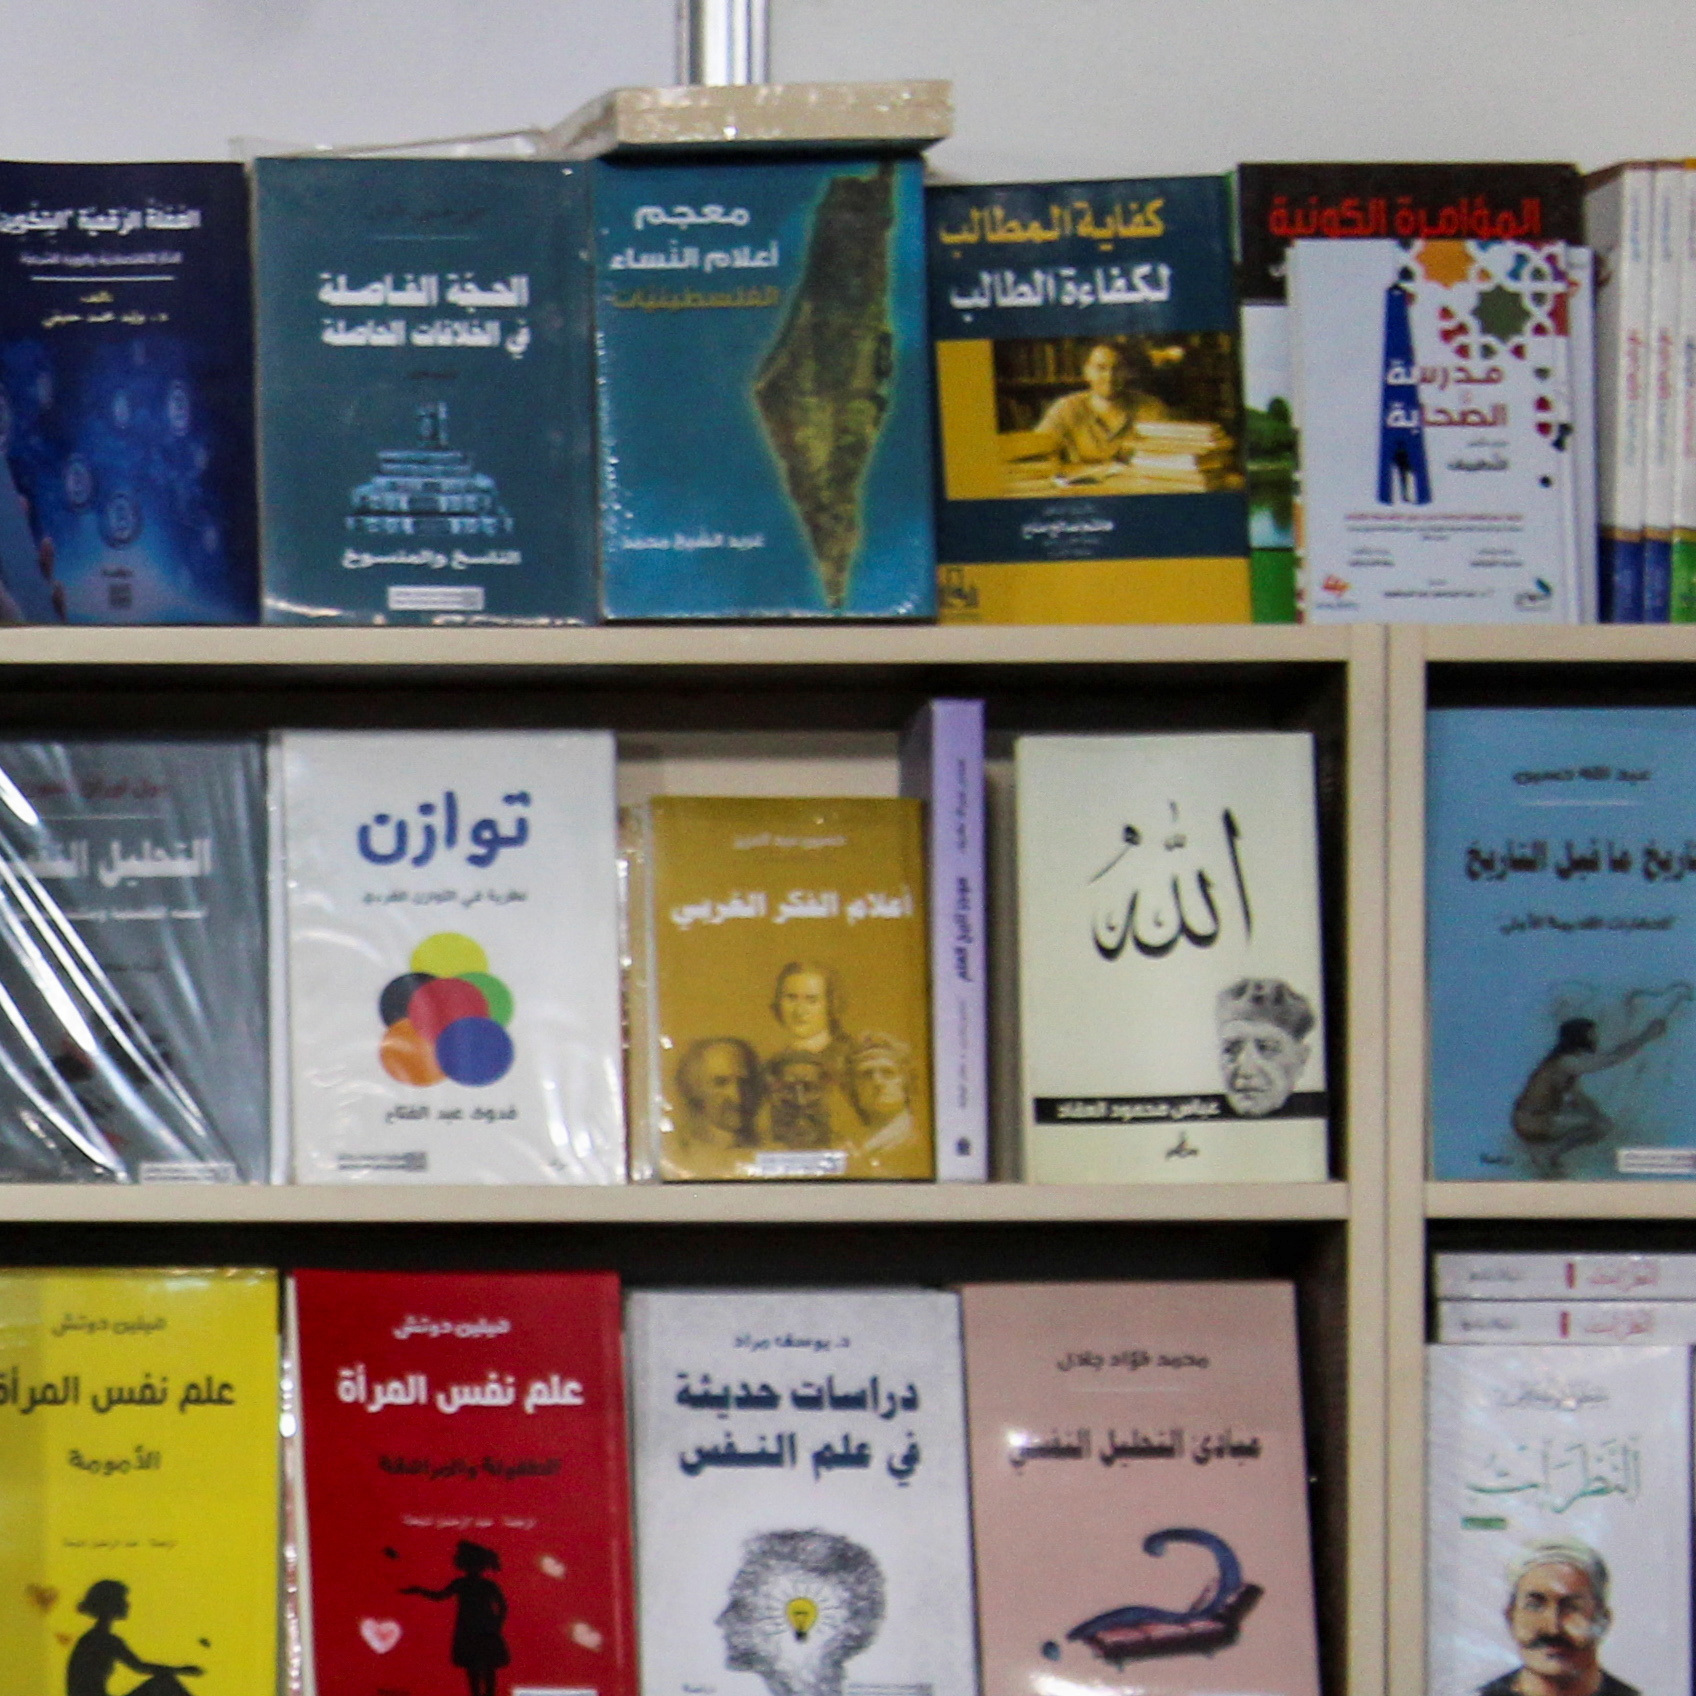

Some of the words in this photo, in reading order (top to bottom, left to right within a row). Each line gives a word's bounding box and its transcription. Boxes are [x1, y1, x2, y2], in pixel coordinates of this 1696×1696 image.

[635, 203, 751, 231] معجم
[937, 206, 1072, 261] المطالب
[1076, 199, 1166, 252] كفاية
[1268, 197, 1388, 237] الكونية
[1394, 198, 1542, 237] المؤامرة
[705, 240, 779, 274] أعلام
[949, 268, 1058, 323] الطالب
[507, 321, 530, 360] في
[1386, 362, 1504, 391] مدرسة
[1387, 405, 1507, 437] الصحابة
[356, 790, 532, 869] توازن
[778, 893, 839, 923] الفكر
[846, 886, 915, 920] أعلام
[1056, 1099, 1107, 1119] العقاد
[1110, 1100, 1168, 1119] محمود
[91, 1375, 168, 1412] نفس
[178, 1375, 237, 1415] علم
[336, 1363, 428, 1414] المرأة
[435, 1374, 516, 1415] نفس
[523, 1375, 585, 1415] علم
[675, 1374, 782, 1420] حديثة
[790, 1374, 920, 1420] دراسات
[67, 1451, 161, 1477] الأمومة
[679, 1433, 796, 1478] النفس
[812, 1436, 871, 1482] علم
[886, 1437, 920, 1487] في
